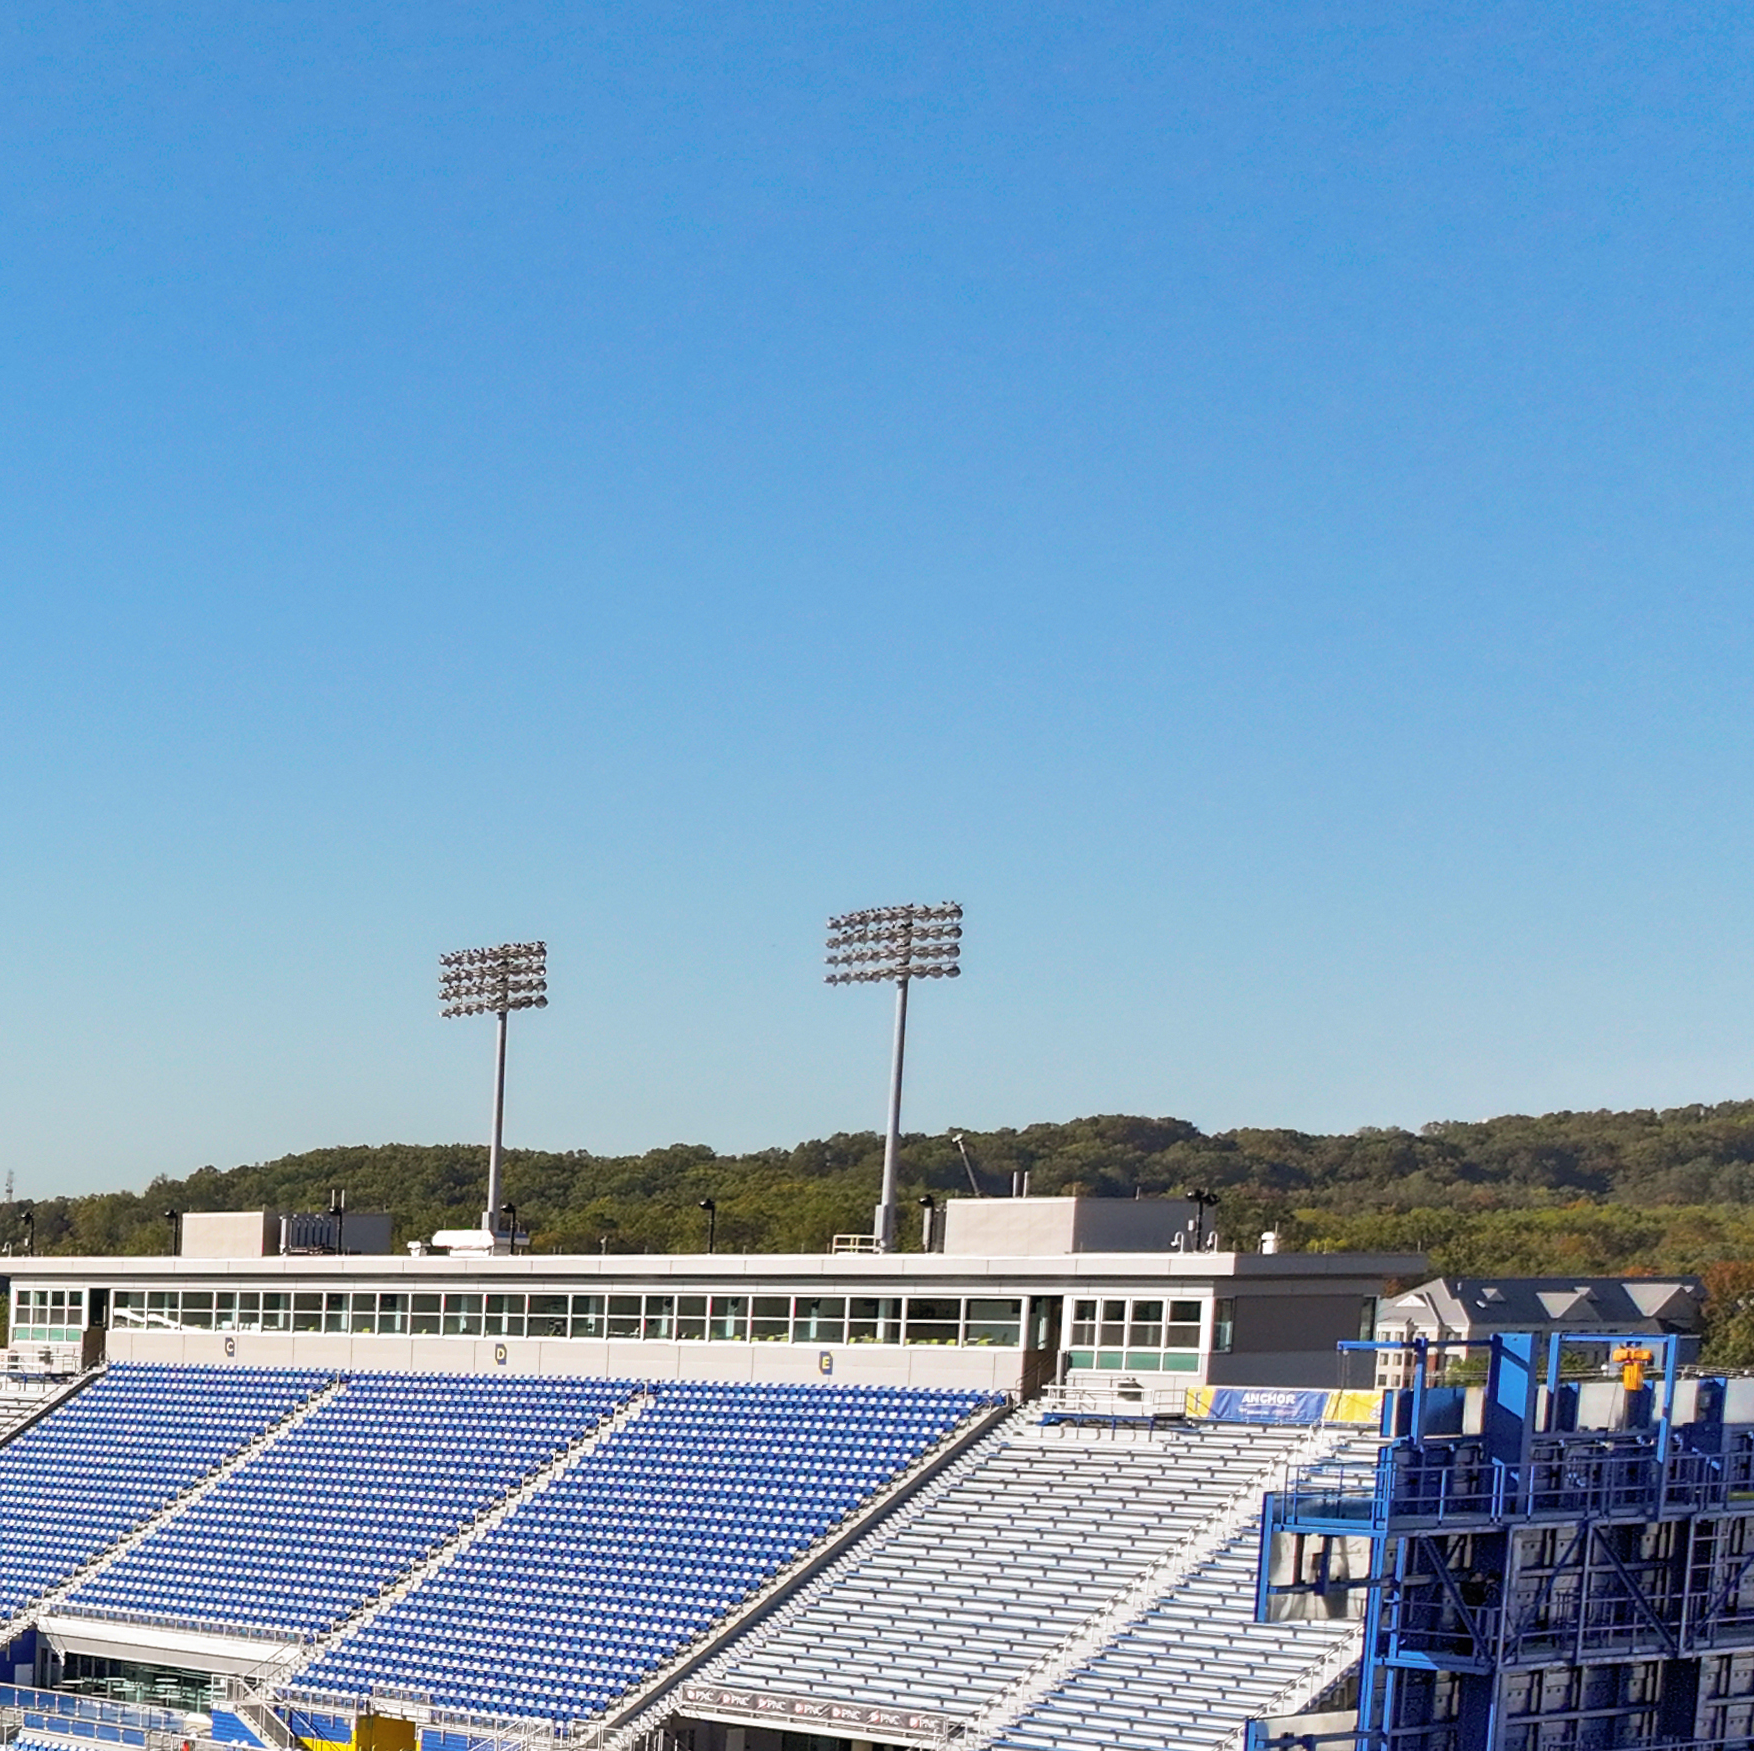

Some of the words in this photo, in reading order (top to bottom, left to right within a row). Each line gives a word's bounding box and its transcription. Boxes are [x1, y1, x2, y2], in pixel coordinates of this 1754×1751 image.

[226, 1341, 234, 1352] C
[496, 1348, 505, 1359] D
[821, 1356, 830, 1369] E
[1242, 1392, 1296, 1405] ANCHOR
